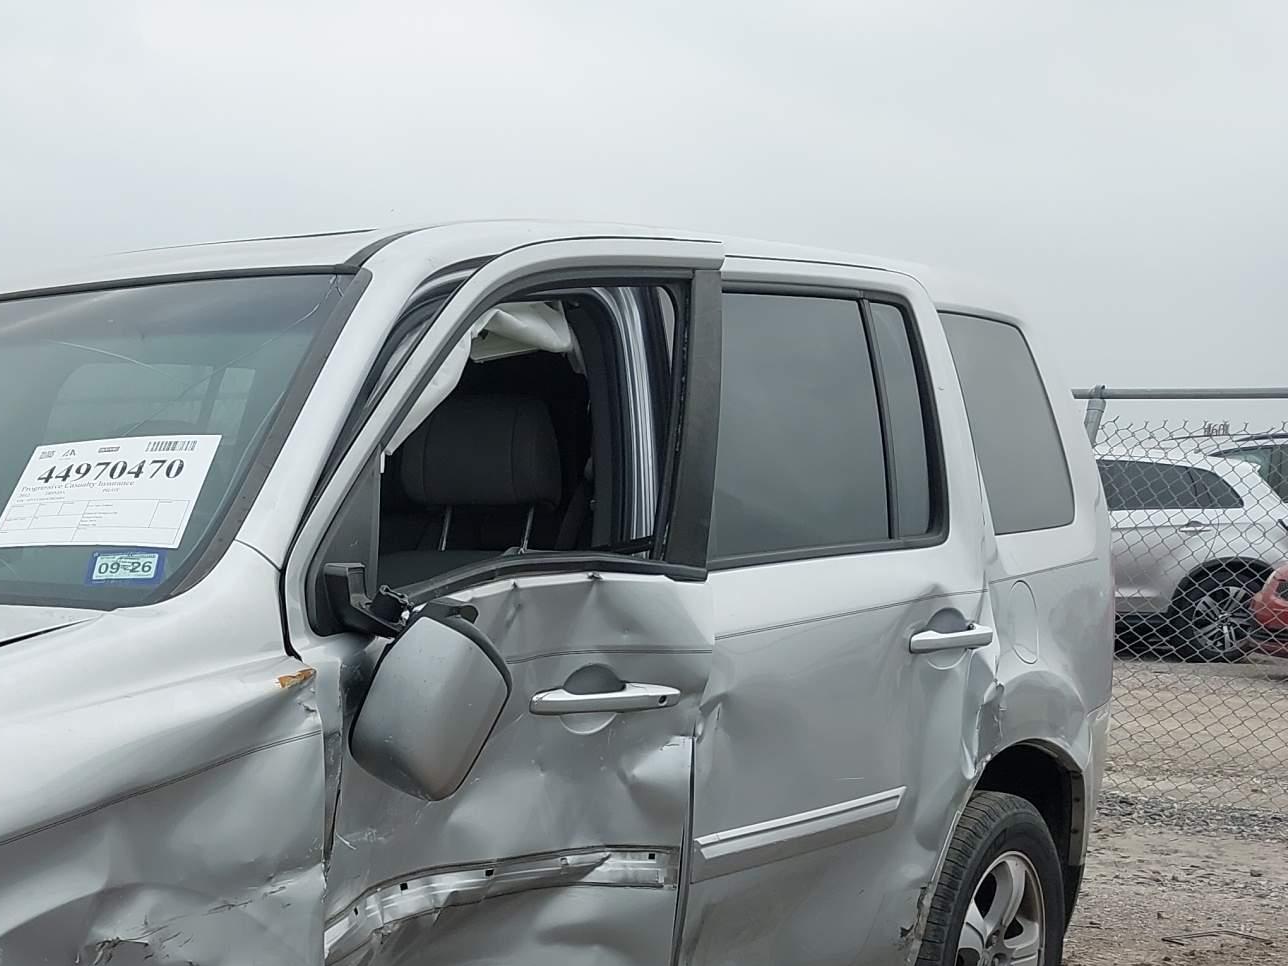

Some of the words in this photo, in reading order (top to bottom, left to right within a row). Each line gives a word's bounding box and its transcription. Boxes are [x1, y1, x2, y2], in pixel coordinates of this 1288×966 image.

[37, 458, 184, 483] 44970470
[98, 562, 121, 574] 09
[130, 561, 153, 574] 26
